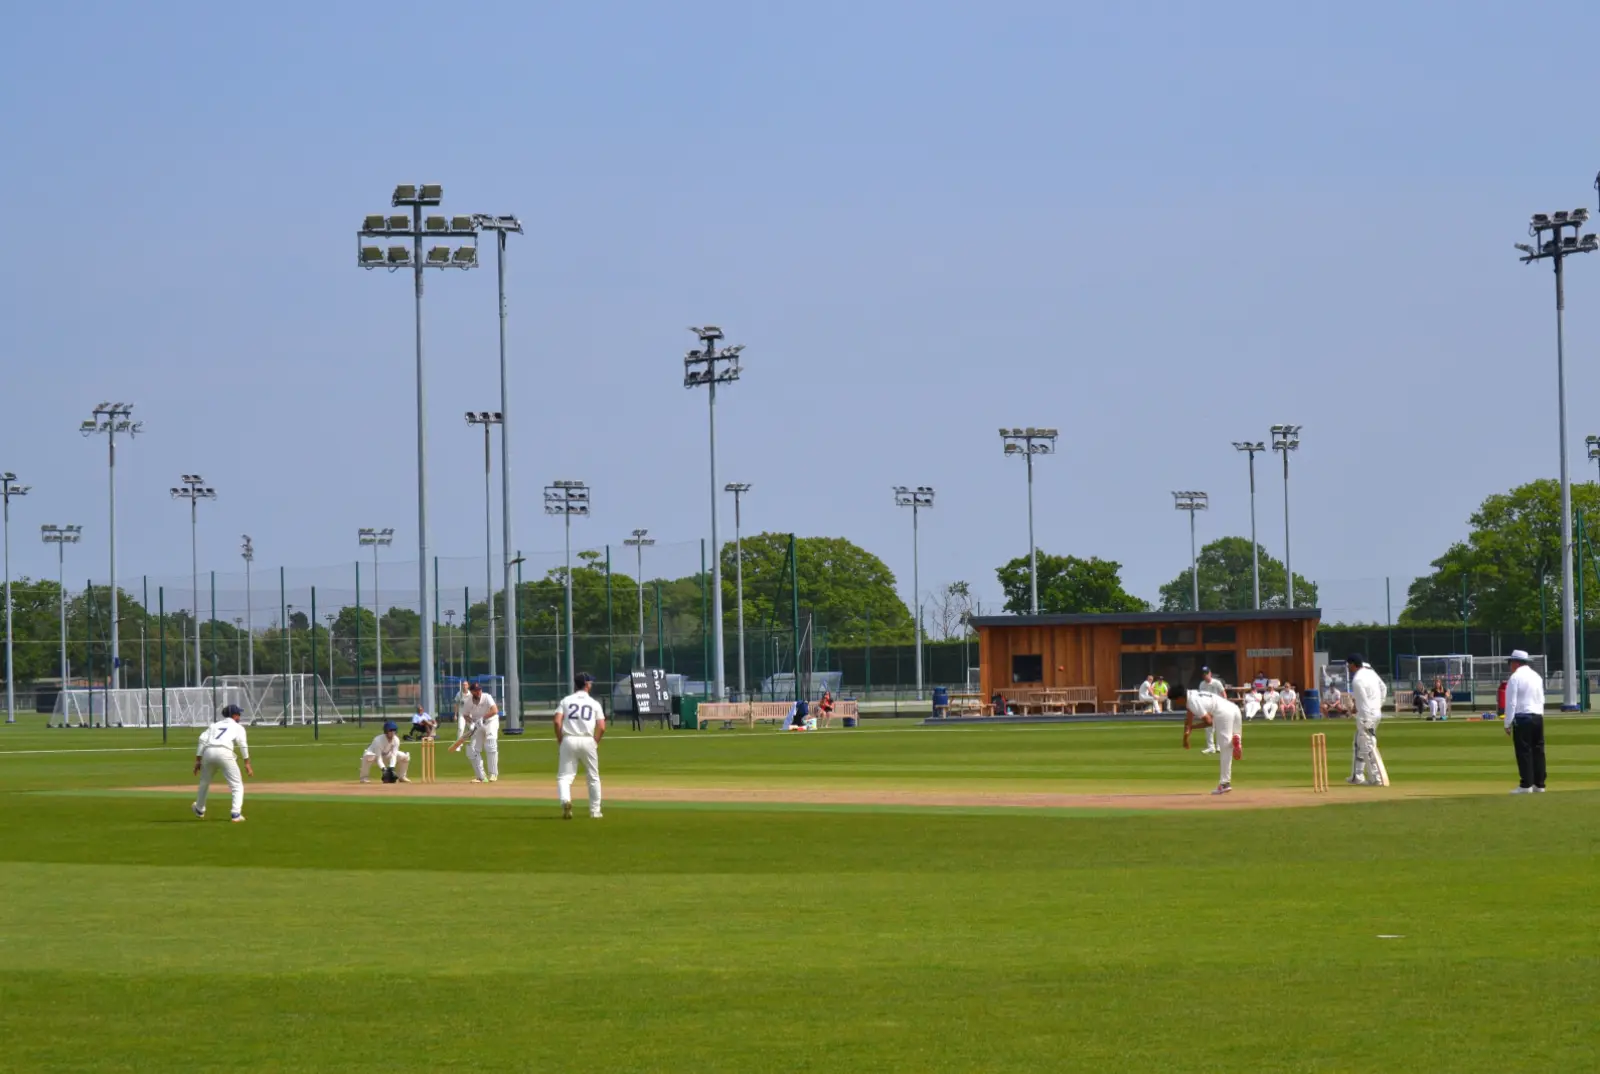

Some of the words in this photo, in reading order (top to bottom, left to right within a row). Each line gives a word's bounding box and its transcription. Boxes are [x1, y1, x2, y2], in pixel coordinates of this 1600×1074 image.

[652, 669, 664, 679] 37
[654, 680, 660, 690] 5
[568, 703, 593, 721] 20
[215, 727, 228, 740] 7
